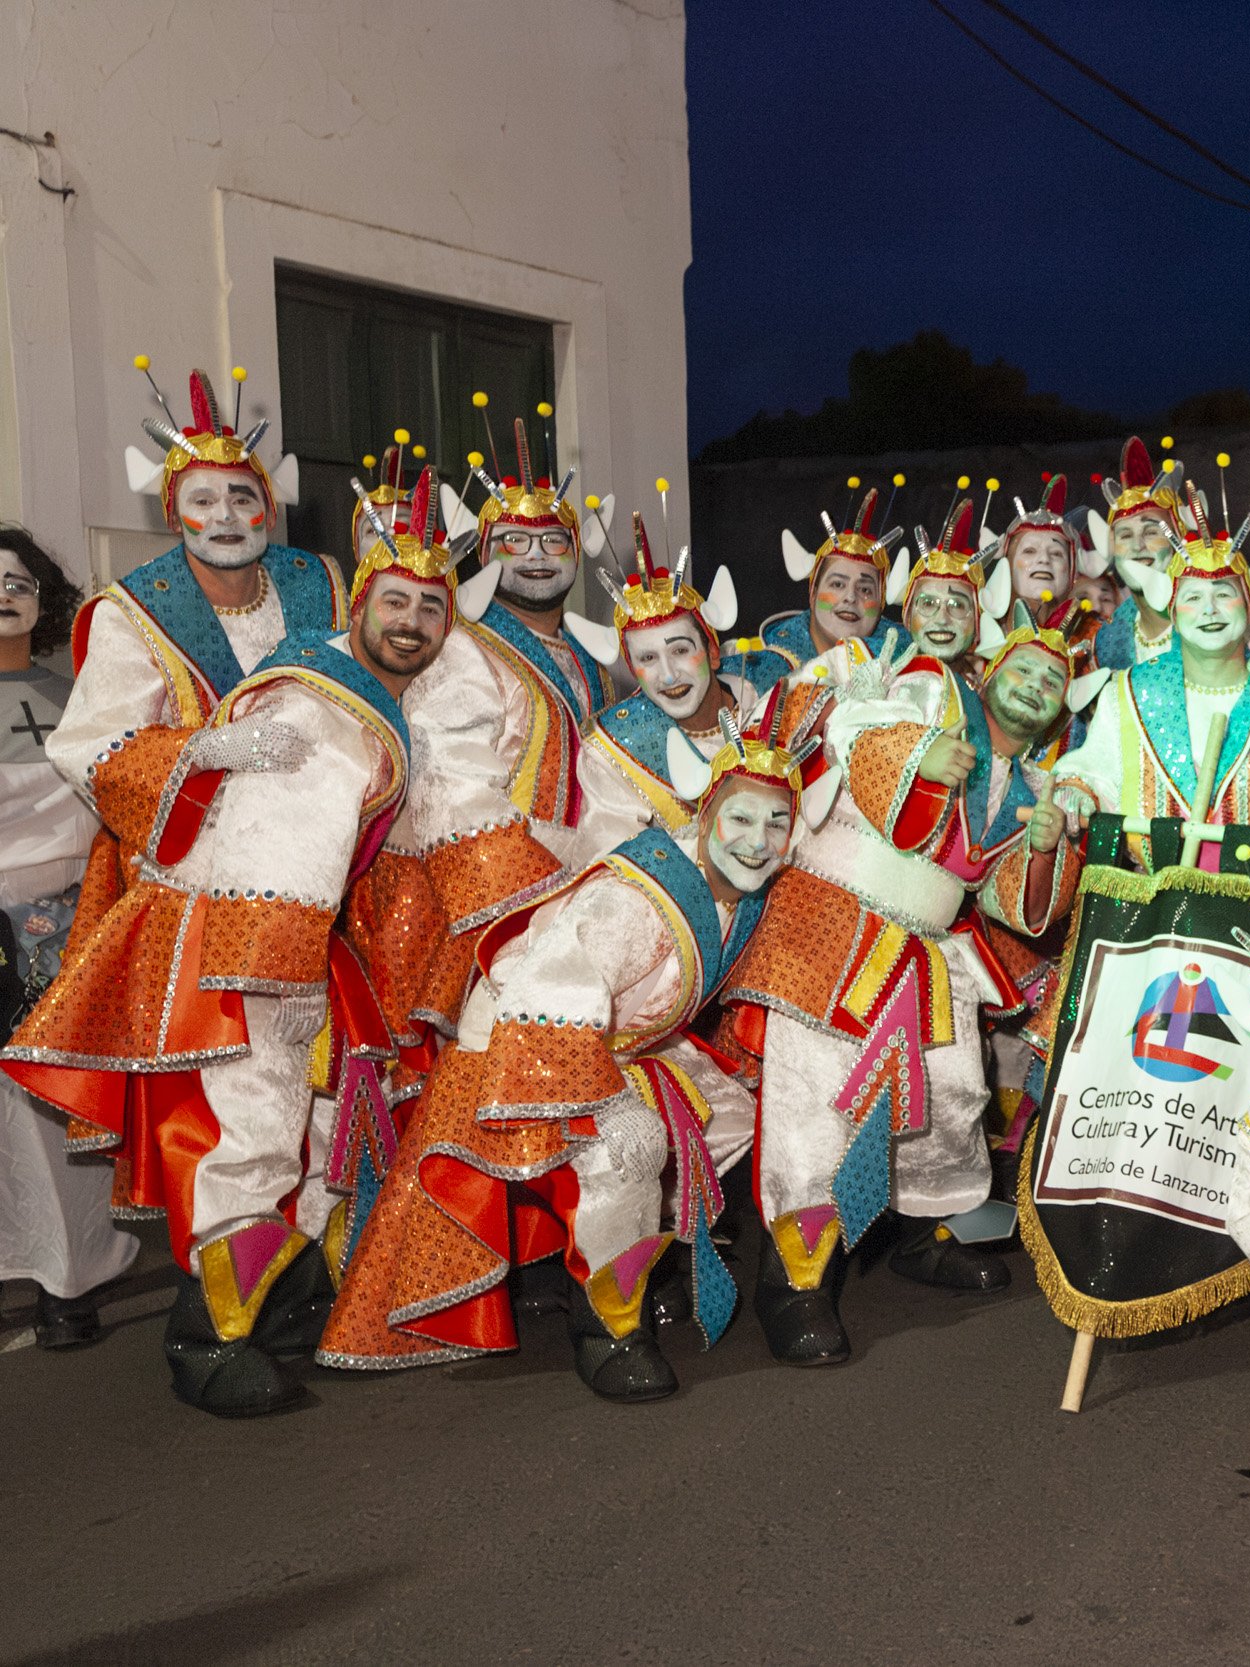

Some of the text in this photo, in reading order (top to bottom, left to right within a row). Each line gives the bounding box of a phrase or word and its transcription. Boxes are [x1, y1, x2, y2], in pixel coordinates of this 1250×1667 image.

[1079, 1086, 1238, 1137] Centros de Art
[1071, 1116, 1237, 1168] Cultura y Turism
[1068, 1157, 1115, 1175] Cabildo
[1120, 1159, 1145, 1179] de
